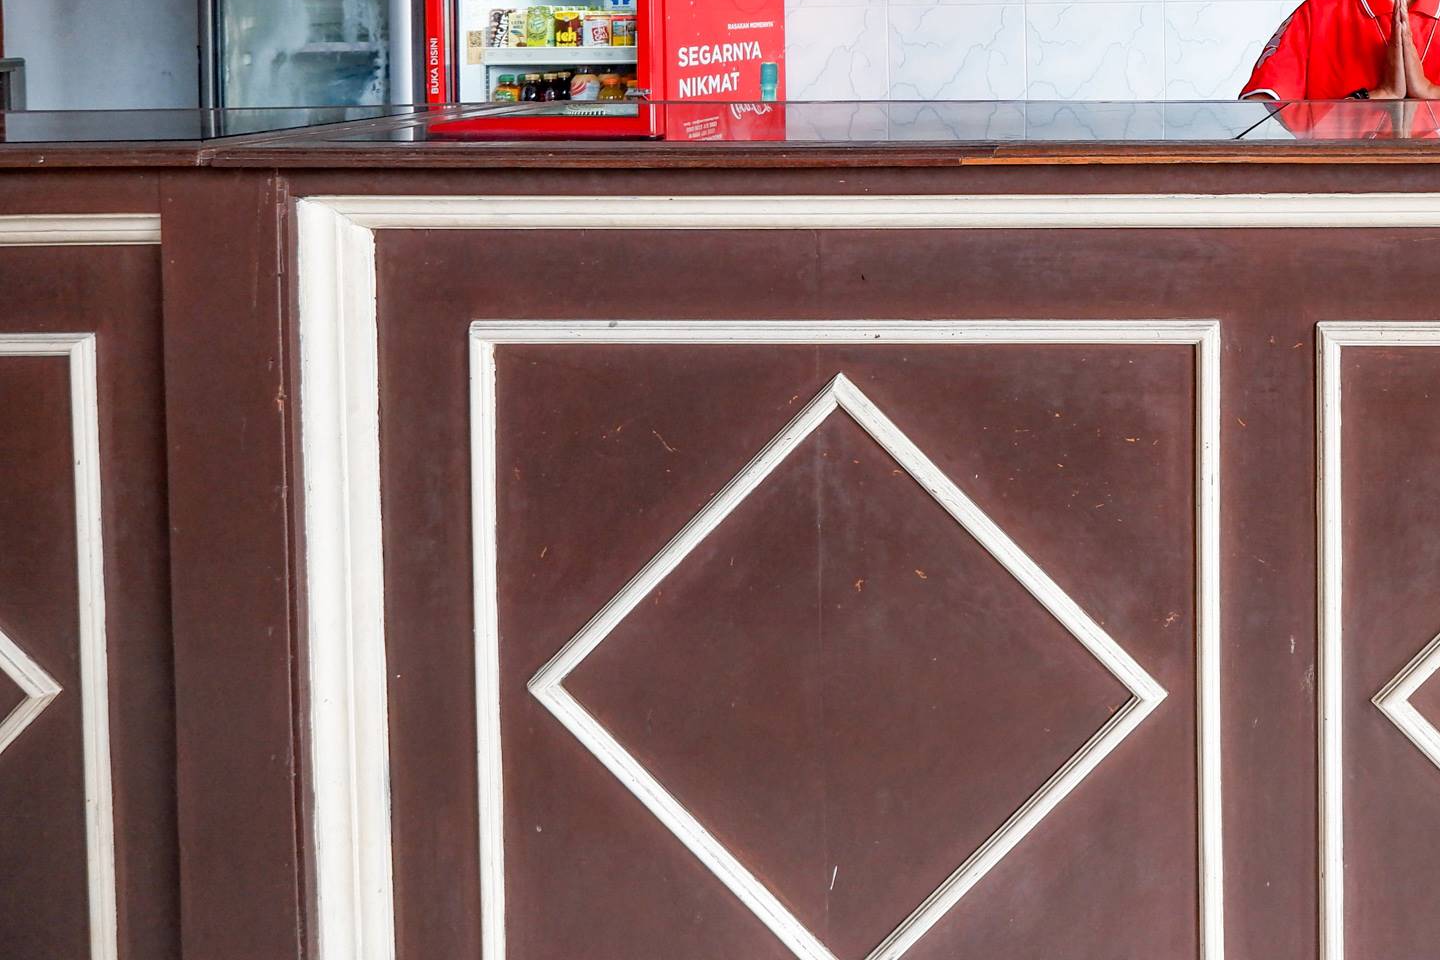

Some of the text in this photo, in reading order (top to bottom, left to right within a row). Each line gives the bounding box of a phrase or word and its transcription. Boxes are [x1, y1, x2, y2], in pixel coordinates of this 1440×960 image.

[556, 27, 576, 42] teh
[430, 37, 439, 94] BUKA DISINI
[678, 41, 762, 67] SEGARNYA
[679, 71, 740, 98] NIKMAT
